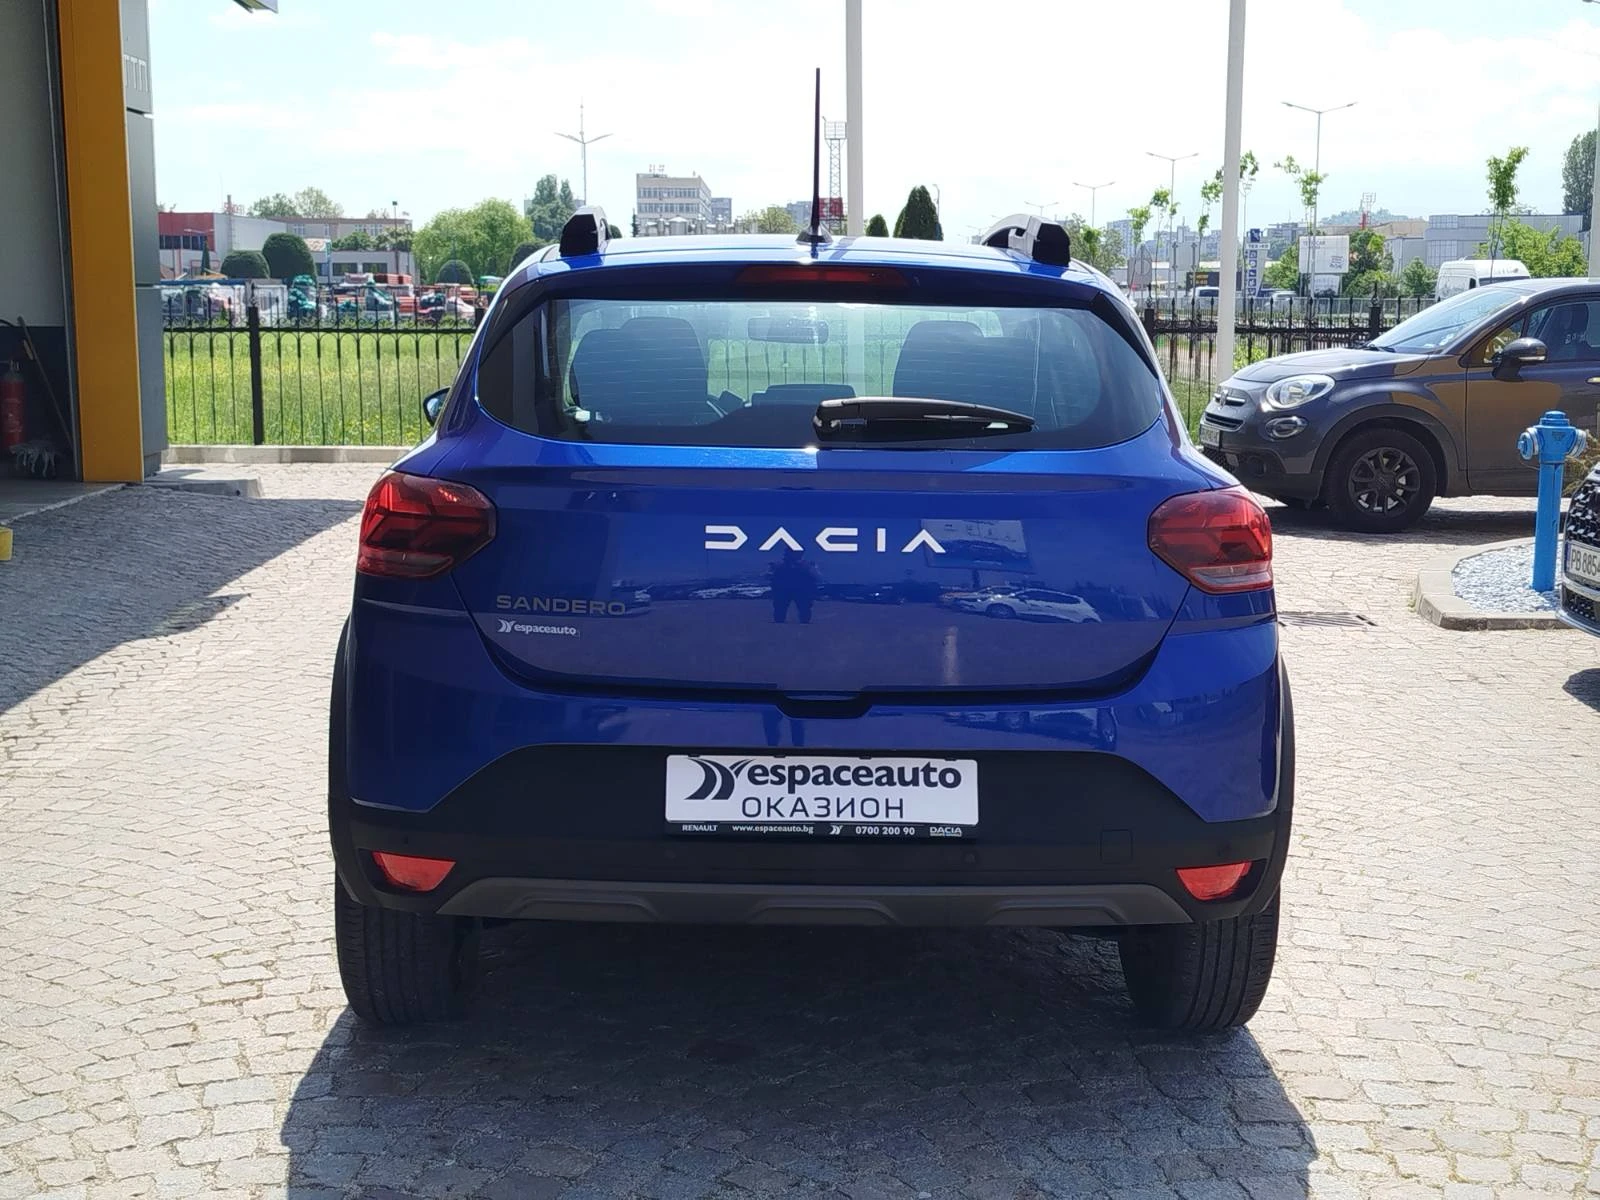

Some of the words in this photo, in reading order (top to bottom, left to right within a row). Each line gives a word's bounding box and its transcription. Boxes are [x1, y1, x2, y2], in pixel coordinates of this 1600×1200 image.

[705, 525, 946, 553] DACIA
[1582, 553, 1600, 576] 885
[496, 594, 626, 616] SANDERO
[514, 624, 577, 635] espaceauto
[748, 761, 962, 794] espaceauto
[741, 797, 904, 819] ОКАЗИОН
[682, 824, 718, 832] RENAULT
[732, 825, 814, 834] www.espaceauto.bg
[855, 826, 880, 835] 0700
[882, 826, 900, 835] 200
[903, 827, 916, 836] 90
